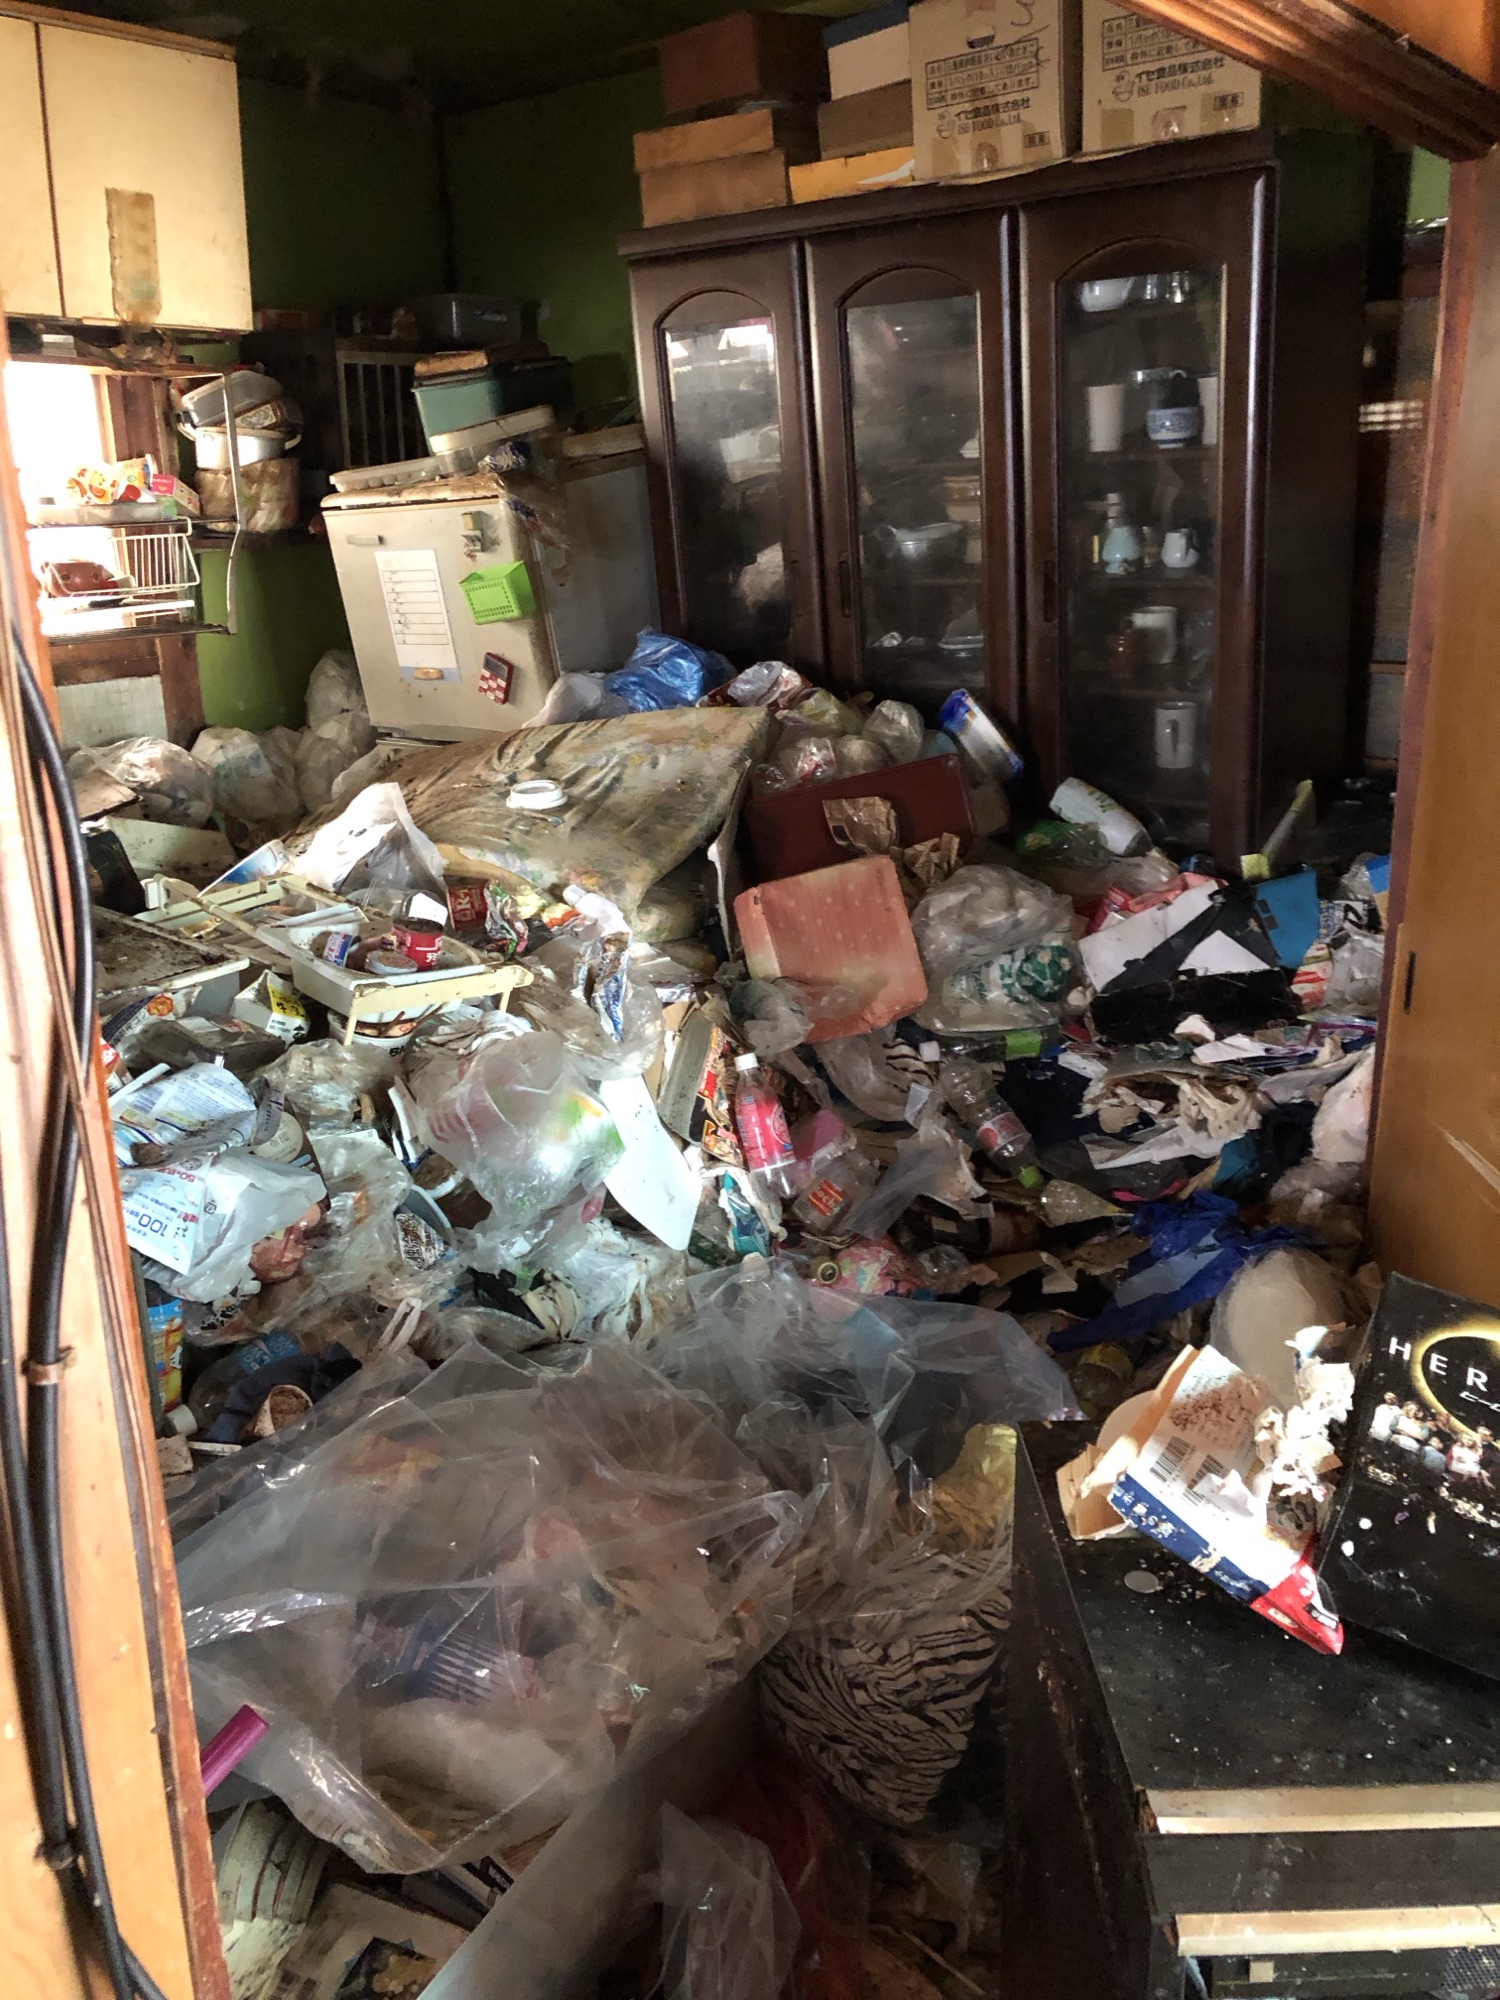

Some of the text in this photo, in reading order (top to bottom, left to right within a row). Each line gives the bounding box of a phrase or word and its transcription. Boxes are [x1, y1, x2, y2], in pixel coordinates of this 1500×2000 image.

[1135, 56, 1226, 82] イセ食品株式会社
[1155, 79, 1179, 94] FOOD
[954, 96, 1031, 121] イセ食品株式会社
